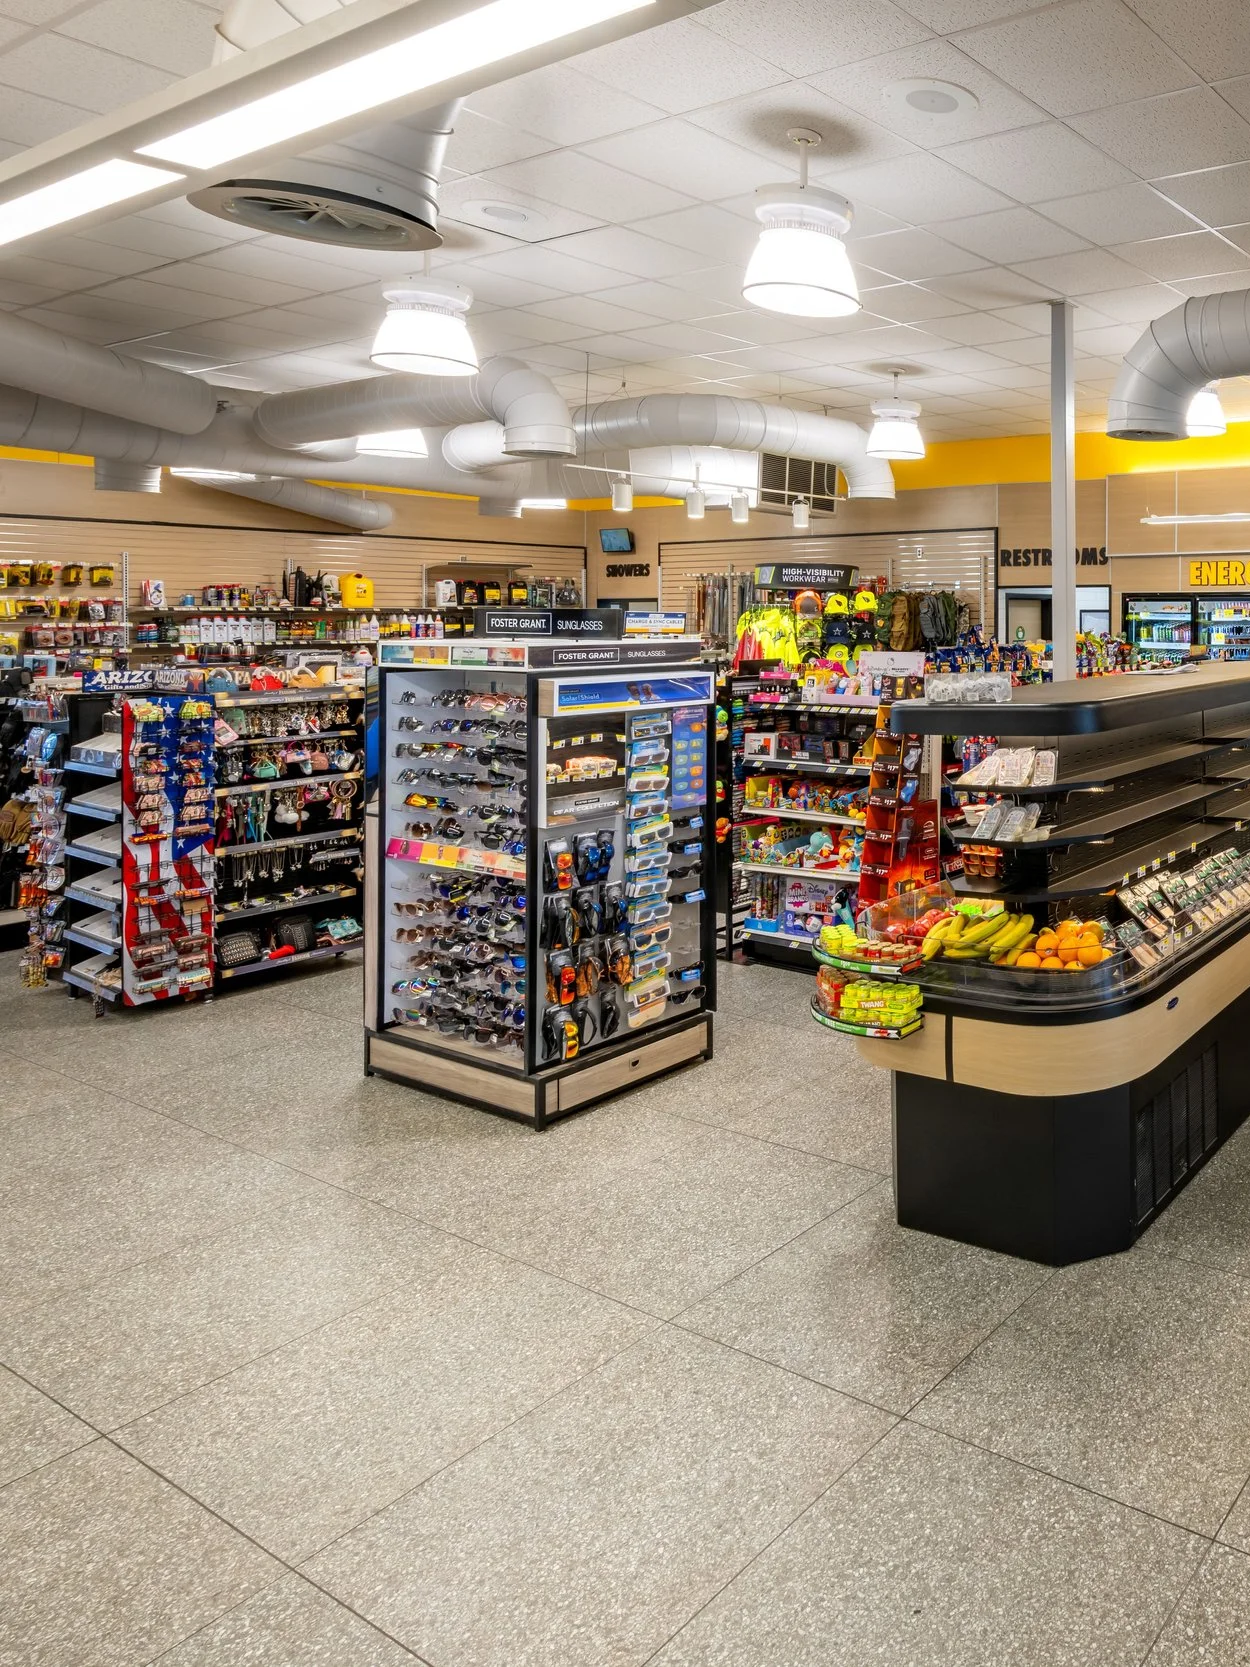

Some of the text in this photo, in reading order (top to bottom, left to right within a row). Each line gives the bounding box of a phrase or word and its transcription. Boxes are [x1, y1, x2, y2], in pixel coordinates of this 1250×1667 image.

[1000, 547, 1108, 567] RESTRMS
[606, 564, 650, 577] SHOWERS
[782, 567, 845, 577] HIGH-VISIBILITY
[782, 575, 826, 583] WORKWEAR
[490, 618, 546, 628] FOSTER GRANT
[556, 620, 603, 631] SUNGLASSES
[558, 651, 614, 660] FOSTER GRANT
[627, 650, 666, 658] SUNGLASSES
[153, 670, 187, 684] ARIZONA
[807, 882, 829, 897] Disney
